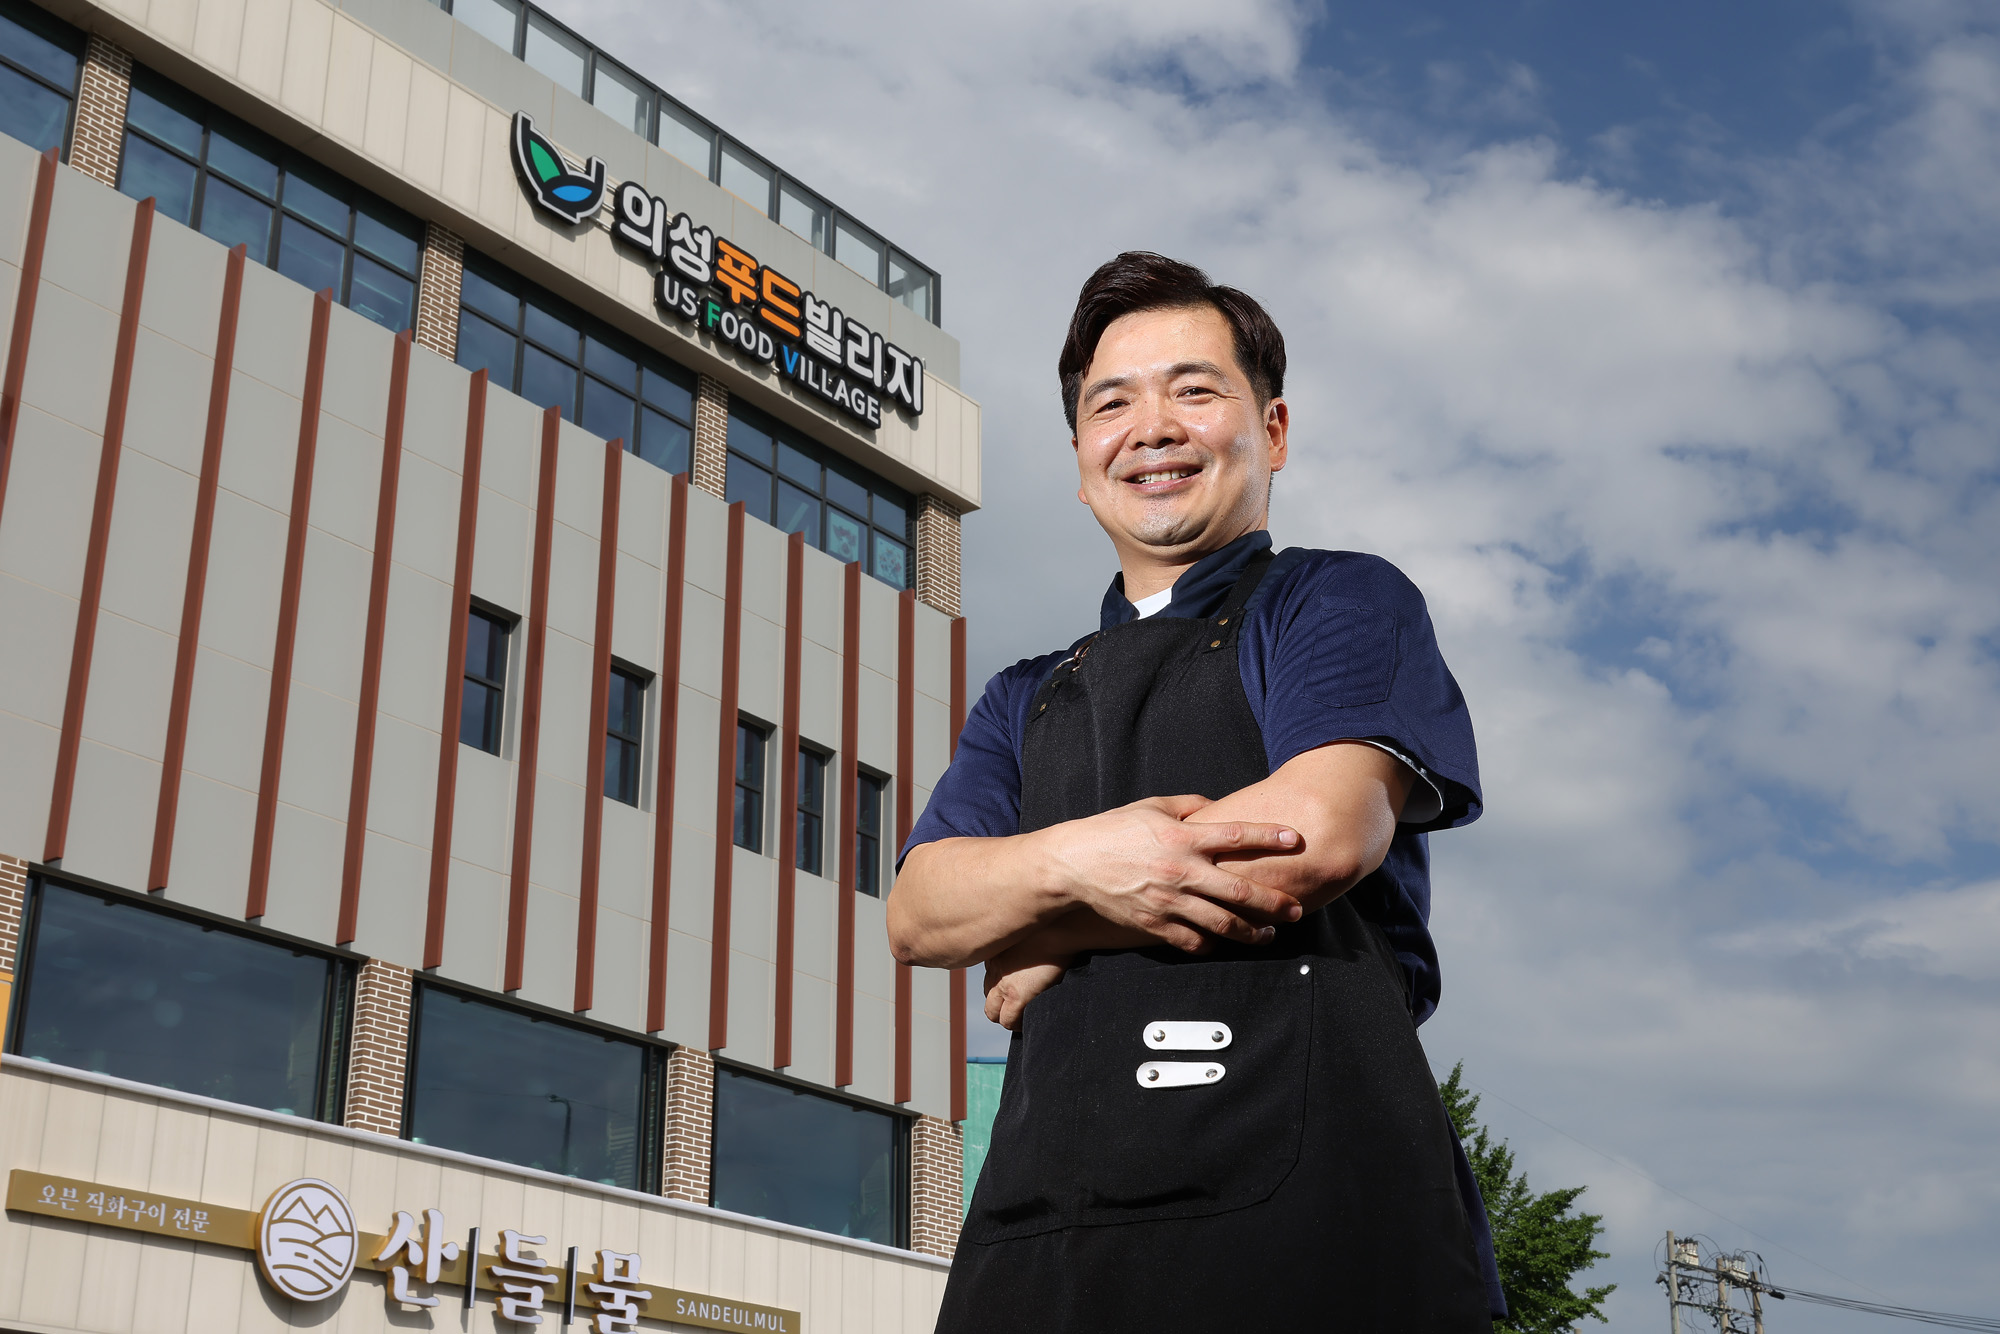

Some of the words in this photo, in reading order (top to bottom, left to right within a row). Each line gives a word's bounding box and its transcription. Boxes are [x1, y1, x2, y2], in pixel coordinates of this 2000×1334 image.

[663, 274, 698, 317] US
[707, 300, 774, 360] FOOD
[782, 344, 879, 425] VILLAGE
[37, 1184, 79, 1211] 오븐
[85, 1191, 167, 1227] 직화구이
[172, 1207, 210, 1233] 전문
[675, 1298, 787, 1333] SANDEULMUL
